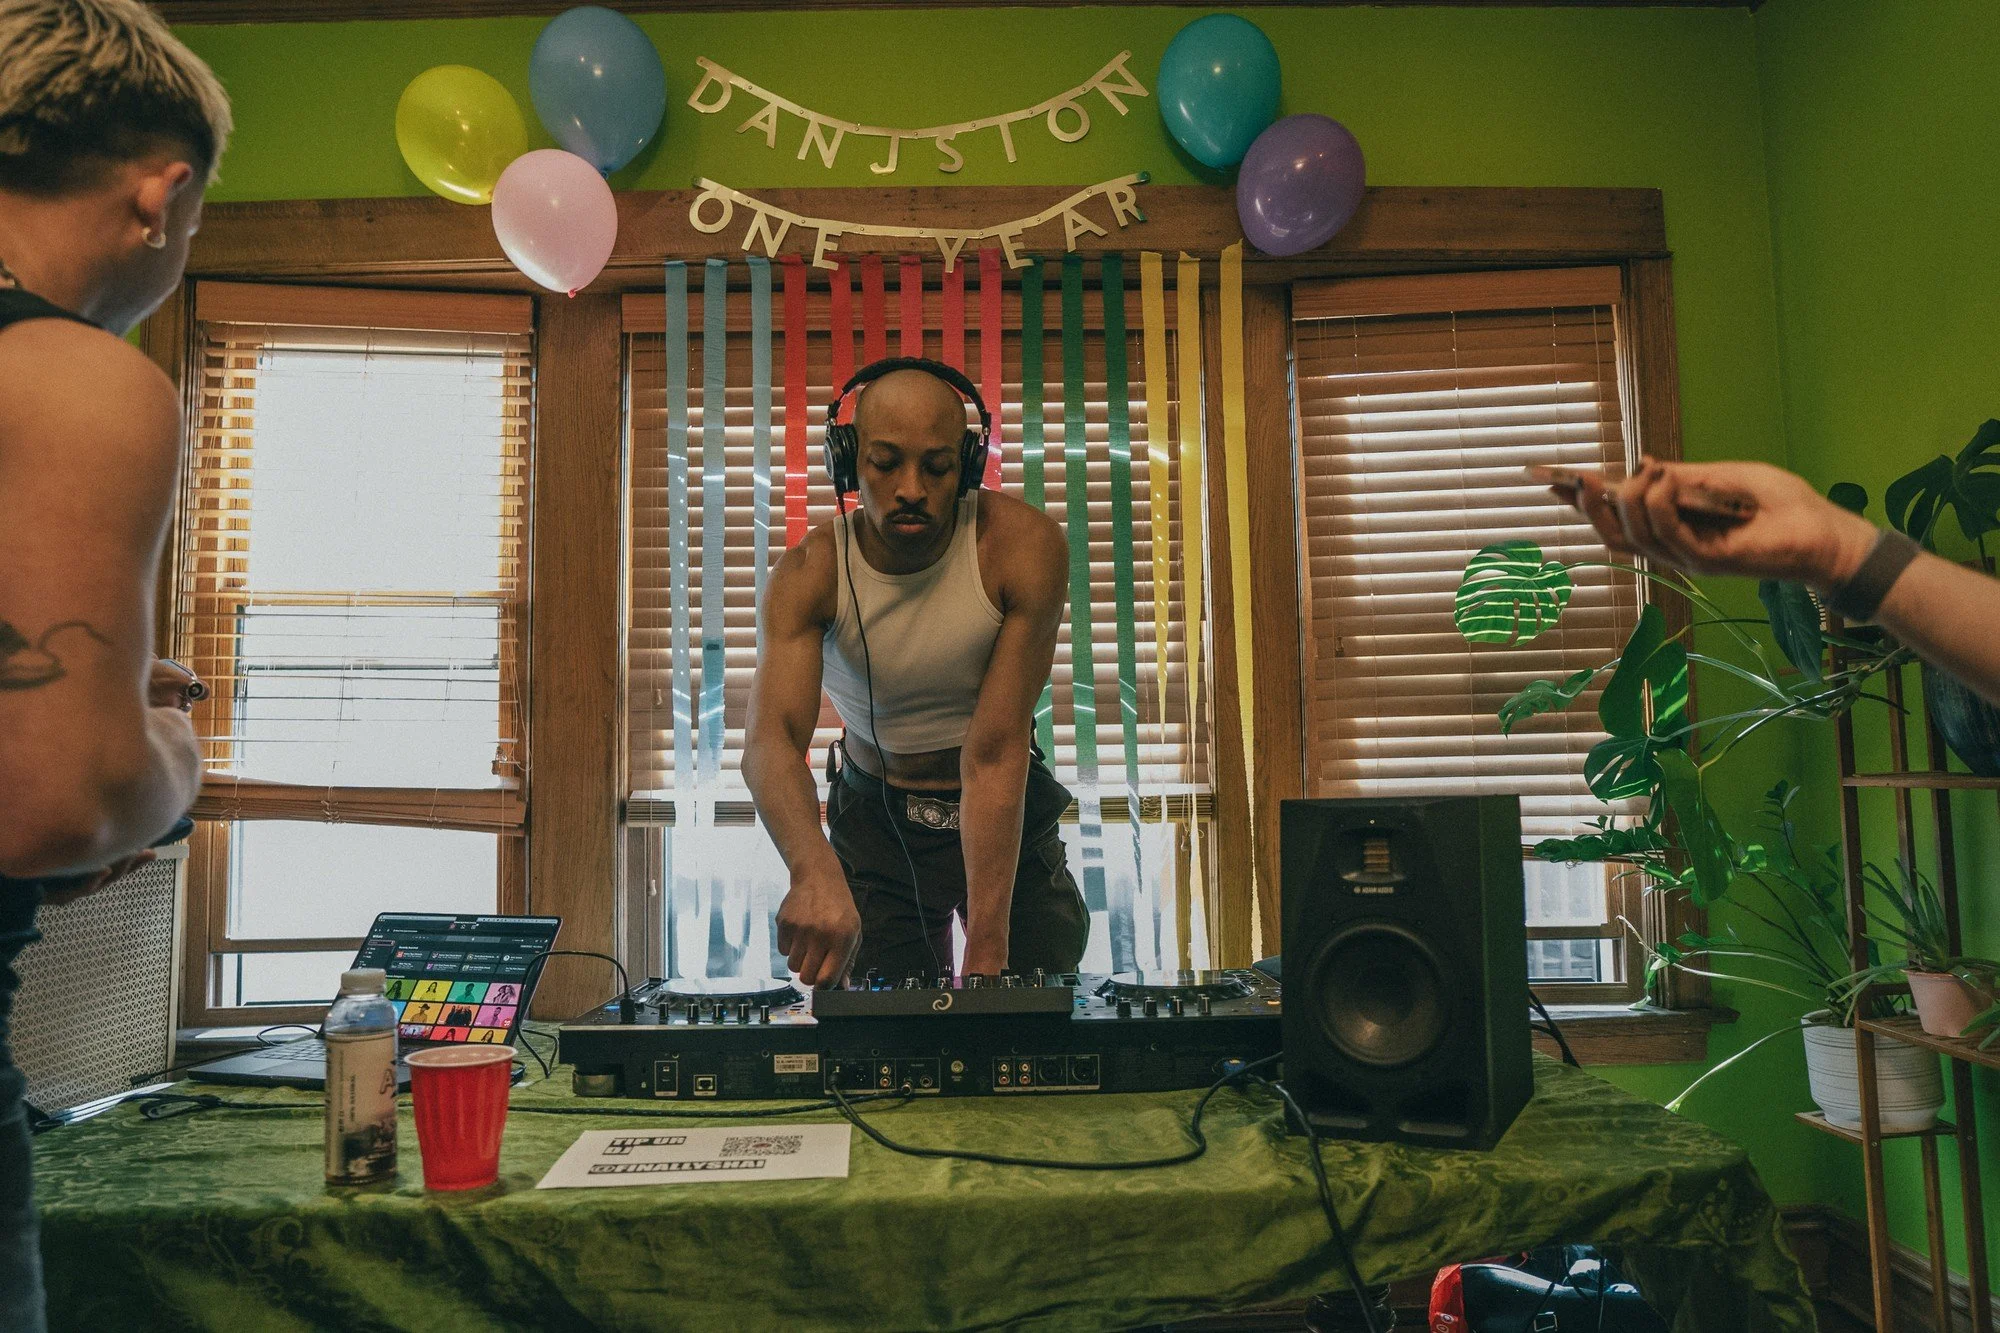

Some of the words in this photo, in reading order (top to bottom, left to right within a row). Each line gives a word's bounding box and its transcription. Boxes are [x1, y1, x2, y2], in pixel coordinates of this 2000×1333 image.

[687, 58, 1149, 175] DANJSTON
[688, 184, 843, 271] ONE
[931, 180, 1148, 274] YEAR
[588, 1159, 766, 1174] @FINALLYSHAI
[609, 1136, 652, 1147] TIP
[652, 1136, 687, 1146] UR
